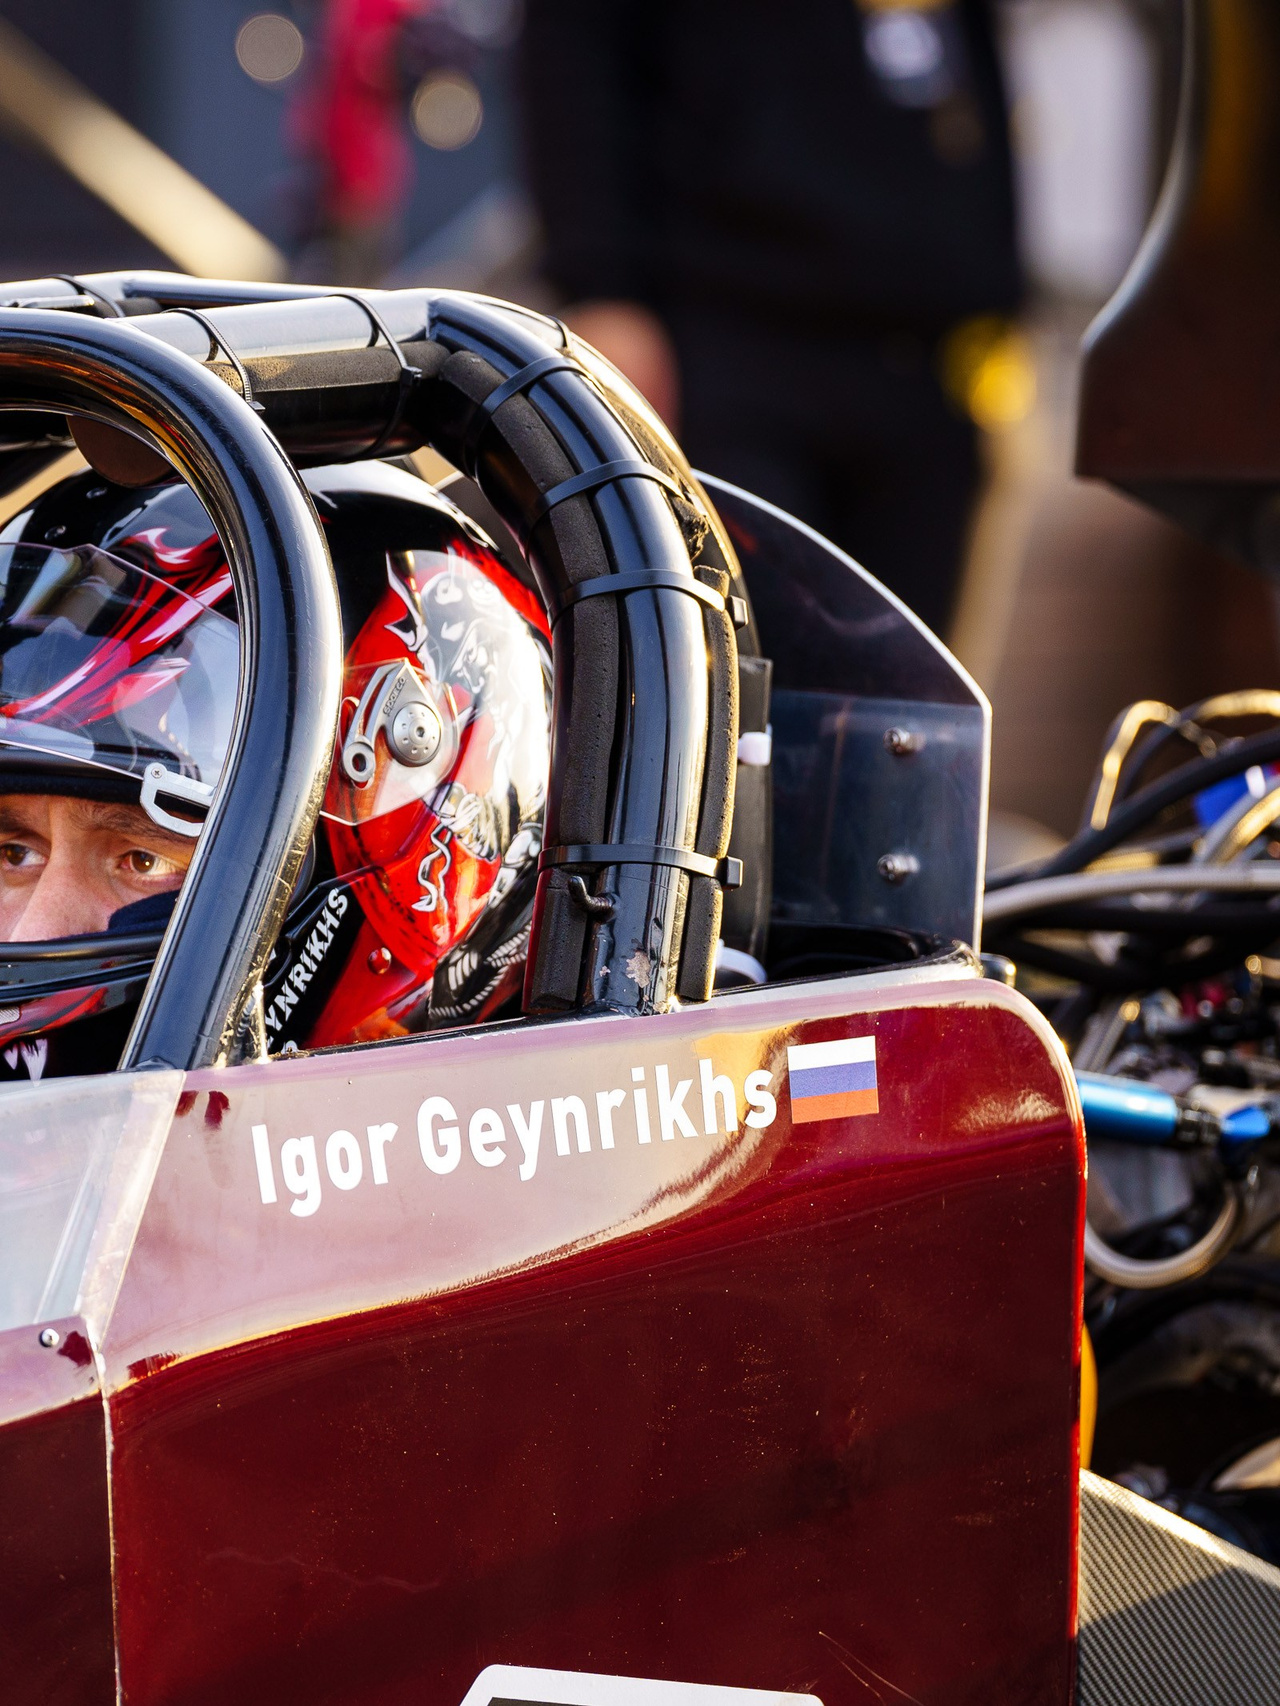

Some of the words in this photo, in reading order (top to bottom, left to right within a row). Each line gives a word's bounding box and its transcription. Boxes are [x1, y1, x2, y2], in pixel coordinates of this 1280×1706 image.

[266, 887, 348, 1048] YNRIKHS
[251, 1121, 399, 1217] Igor
[416, 1057, 778, 1182] Geynrikhs
